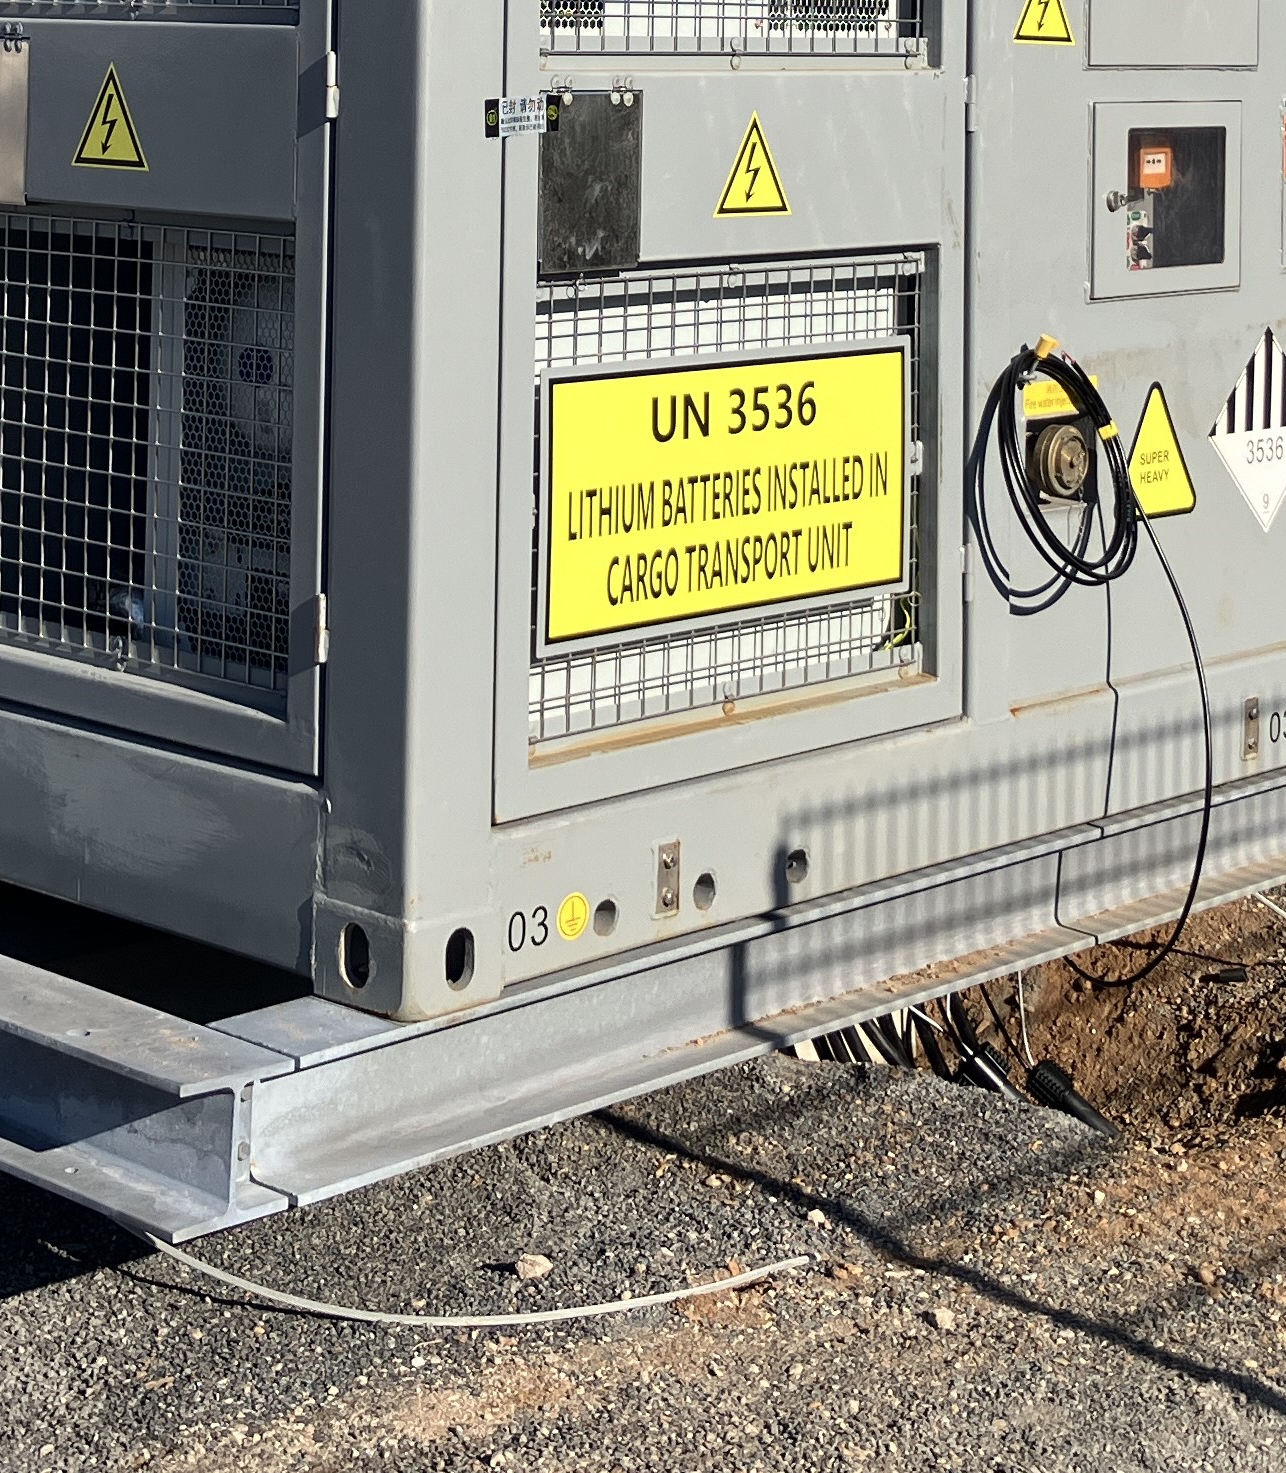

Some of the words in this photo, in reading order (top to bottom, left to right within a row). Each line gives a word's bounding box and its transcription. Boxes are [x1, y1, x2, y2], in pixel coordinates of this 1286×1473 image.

[652, 391, 710, 443] UN
[728, 380, 817, 435] 3536
[1140, 449, 1170, 466] SUPER
[1246, 435, 1284, 464] 3536
[568, 480, 655, 541] LITHIUM
[661, 466, 761, 527] BATTERIES
[767, 454, 864, 513] INSTALLED
[869, 450, 888, 498] IN
[1140, 469, 1170, 484] HEAVY
[1262, 493, 1270, 509] 9
[607, 546, 679, 606] CARGO
[685, 528, 803, 593] TRANSPORT
[807, 521, 853, 573] UNIT
[507, 905, 550, 952] 03
